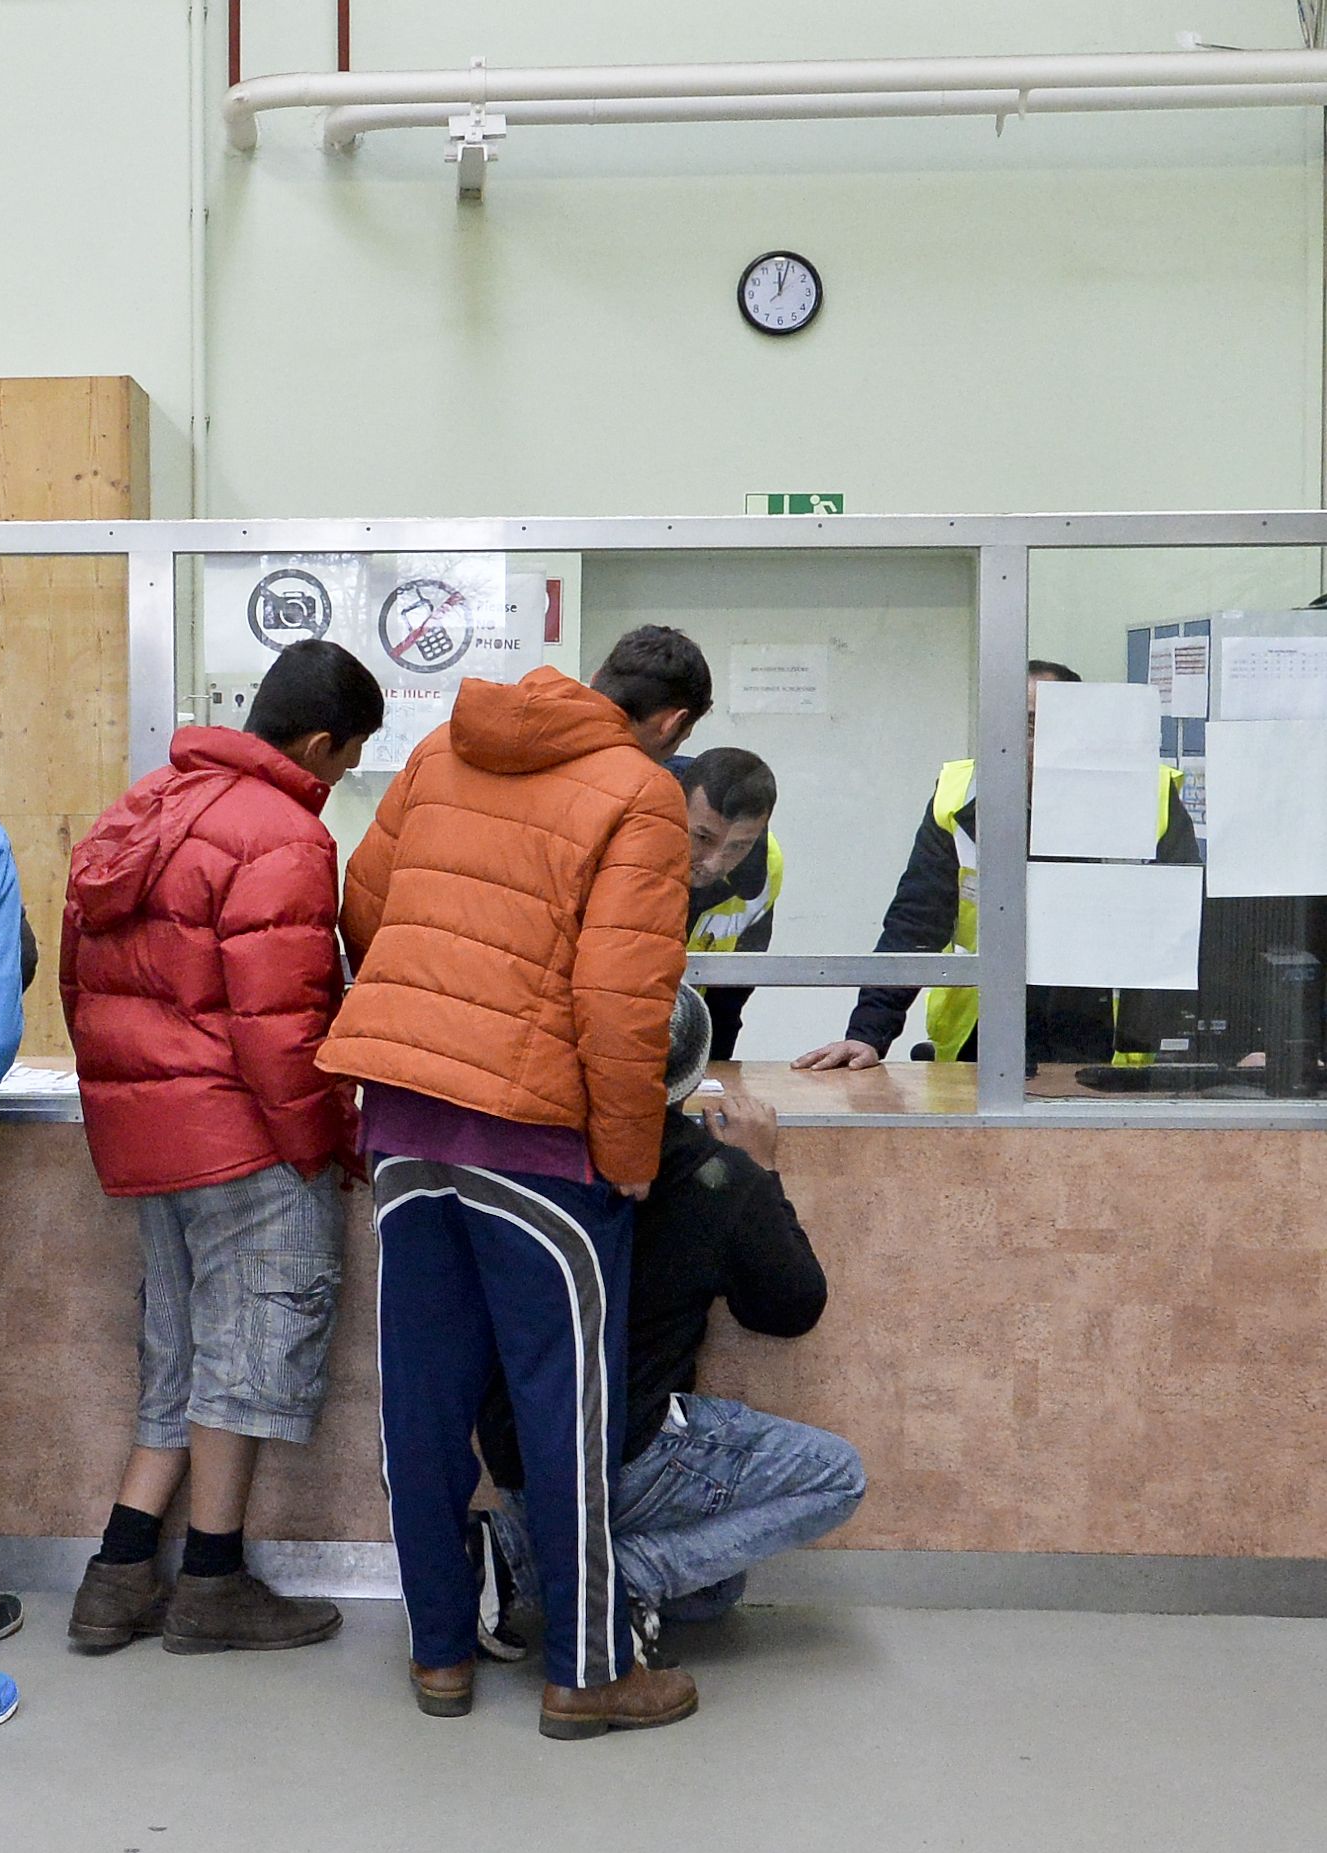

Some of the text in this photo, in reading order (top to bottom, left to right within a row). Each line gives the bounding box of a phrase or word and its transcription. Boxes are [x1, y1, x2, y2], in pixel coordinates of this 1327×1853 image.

[761, 267, 769, 275] 11
[775, 262, 784, 271] 12
[791, 265, 795, 273] 1
[752, 278, 760, 287] 10
[800, 273, 807, 283] 2
[748, 290, 754, 299] 9
[805, 288, 811, 297] 3
[753, 304, 759, 313] 8
[800, 303, 806, 311] 4
[764, 313, 769, 321] 7
[777, 317, 783, 325] 6
[792, 312, 797, 321] 5
[476, 620, 495, 630] NO
[476, 638, 520, 650] PHONE
